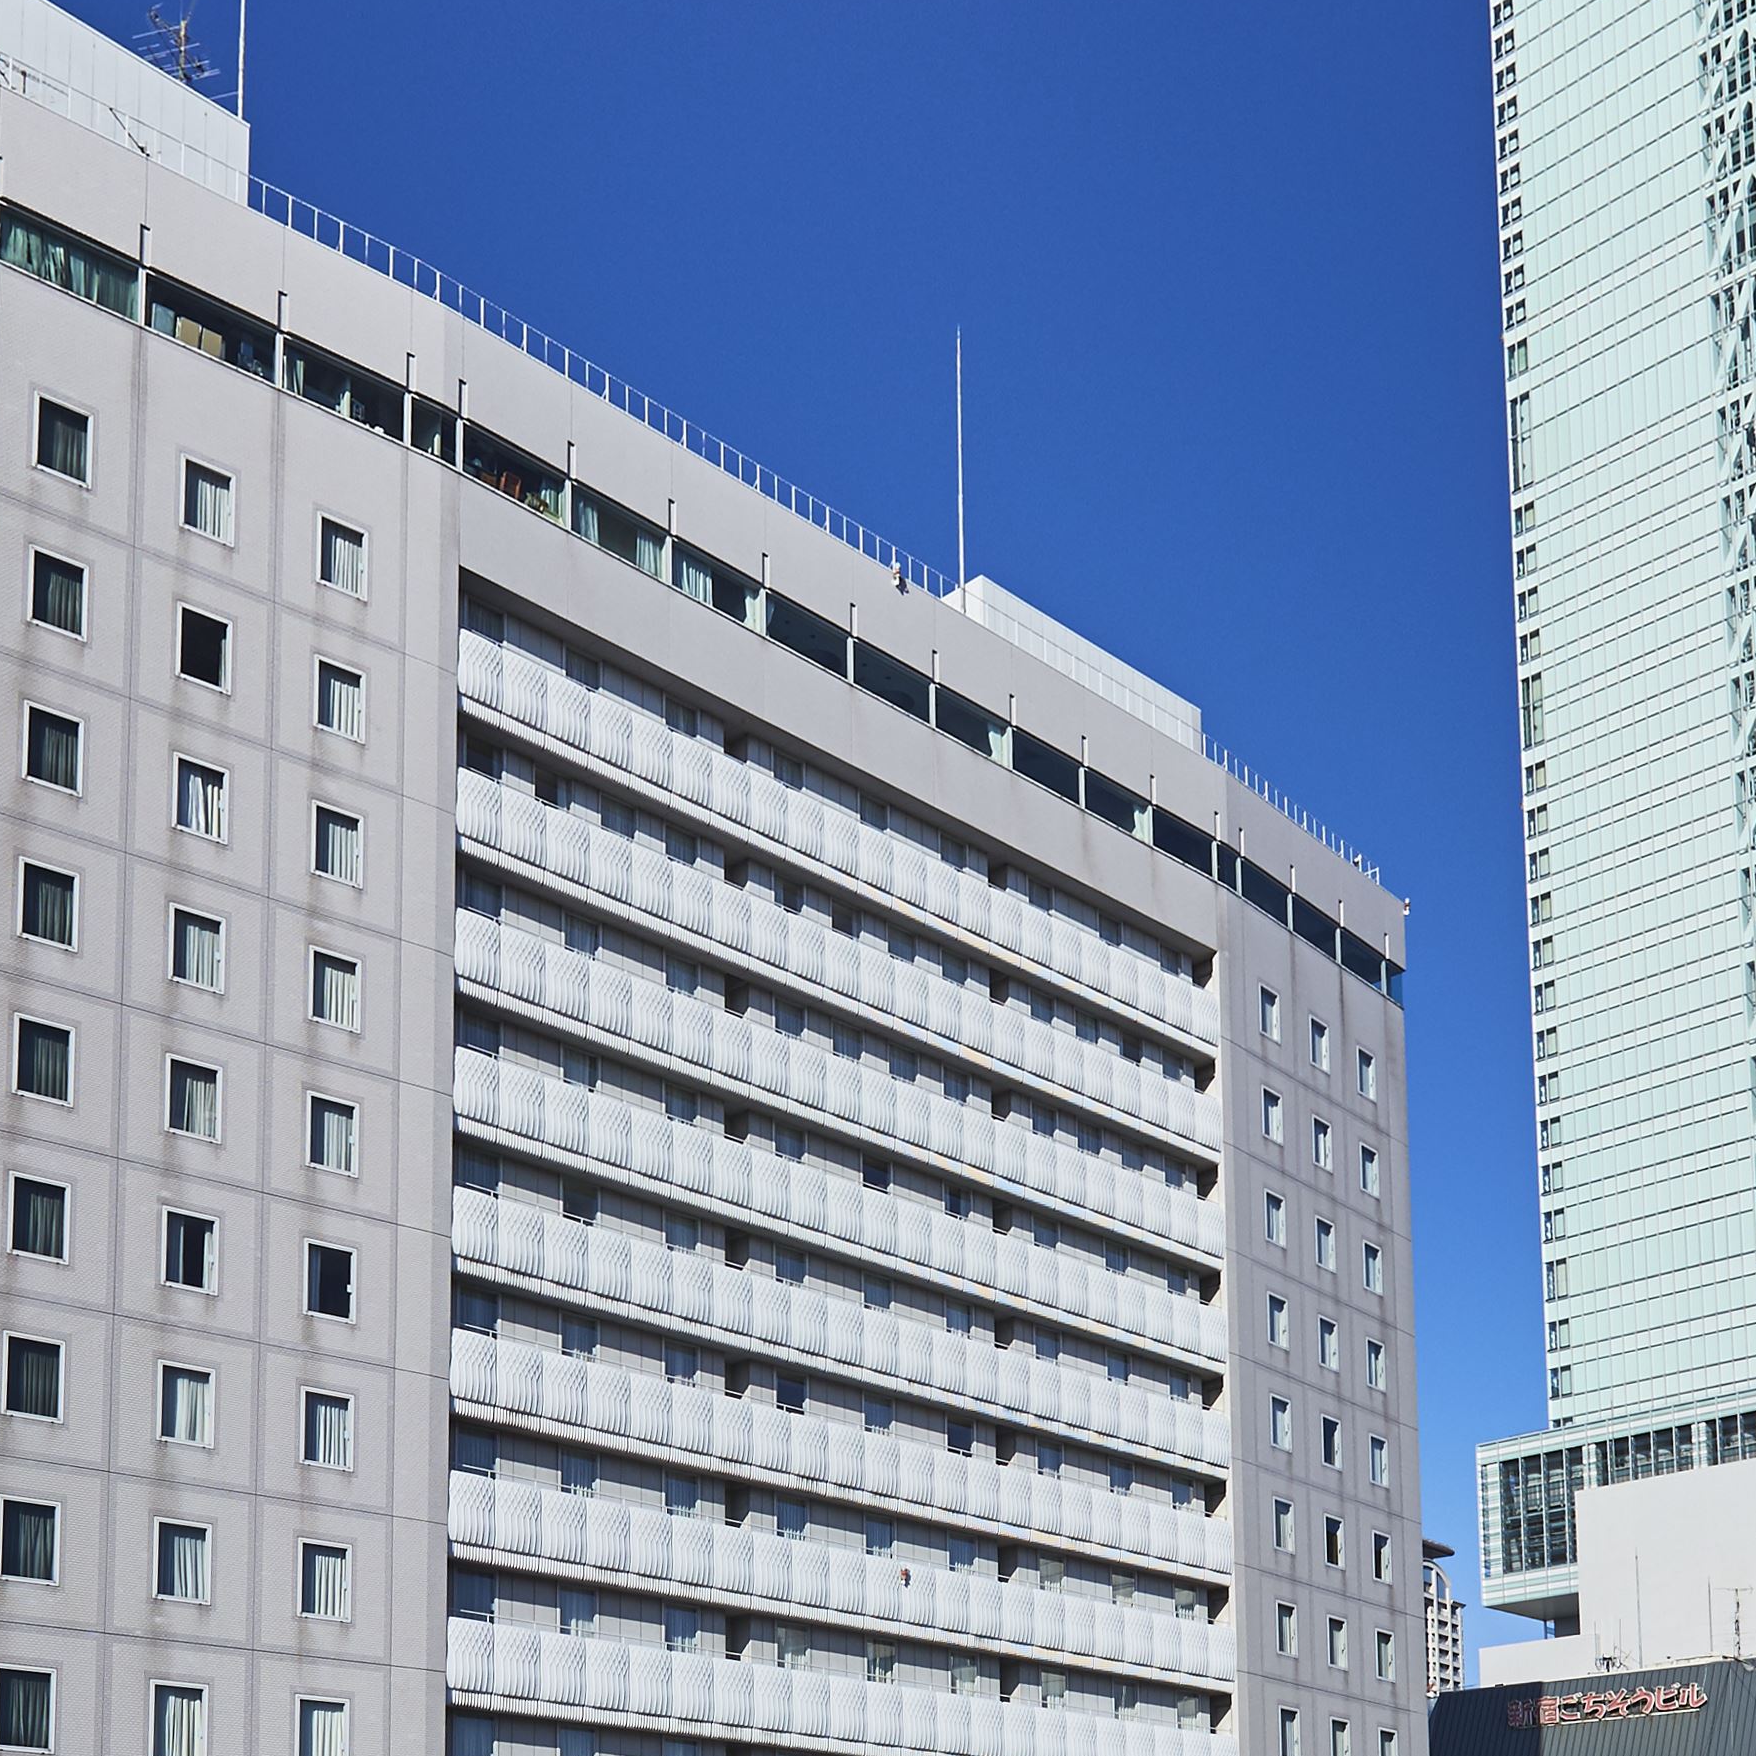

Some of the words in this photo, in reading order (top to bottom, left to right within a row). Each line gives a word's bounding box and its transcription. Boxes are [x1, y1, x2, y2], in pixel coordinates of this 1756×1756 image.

[1508, 1683, 1708, 1726] 新宿ごちそうビル
